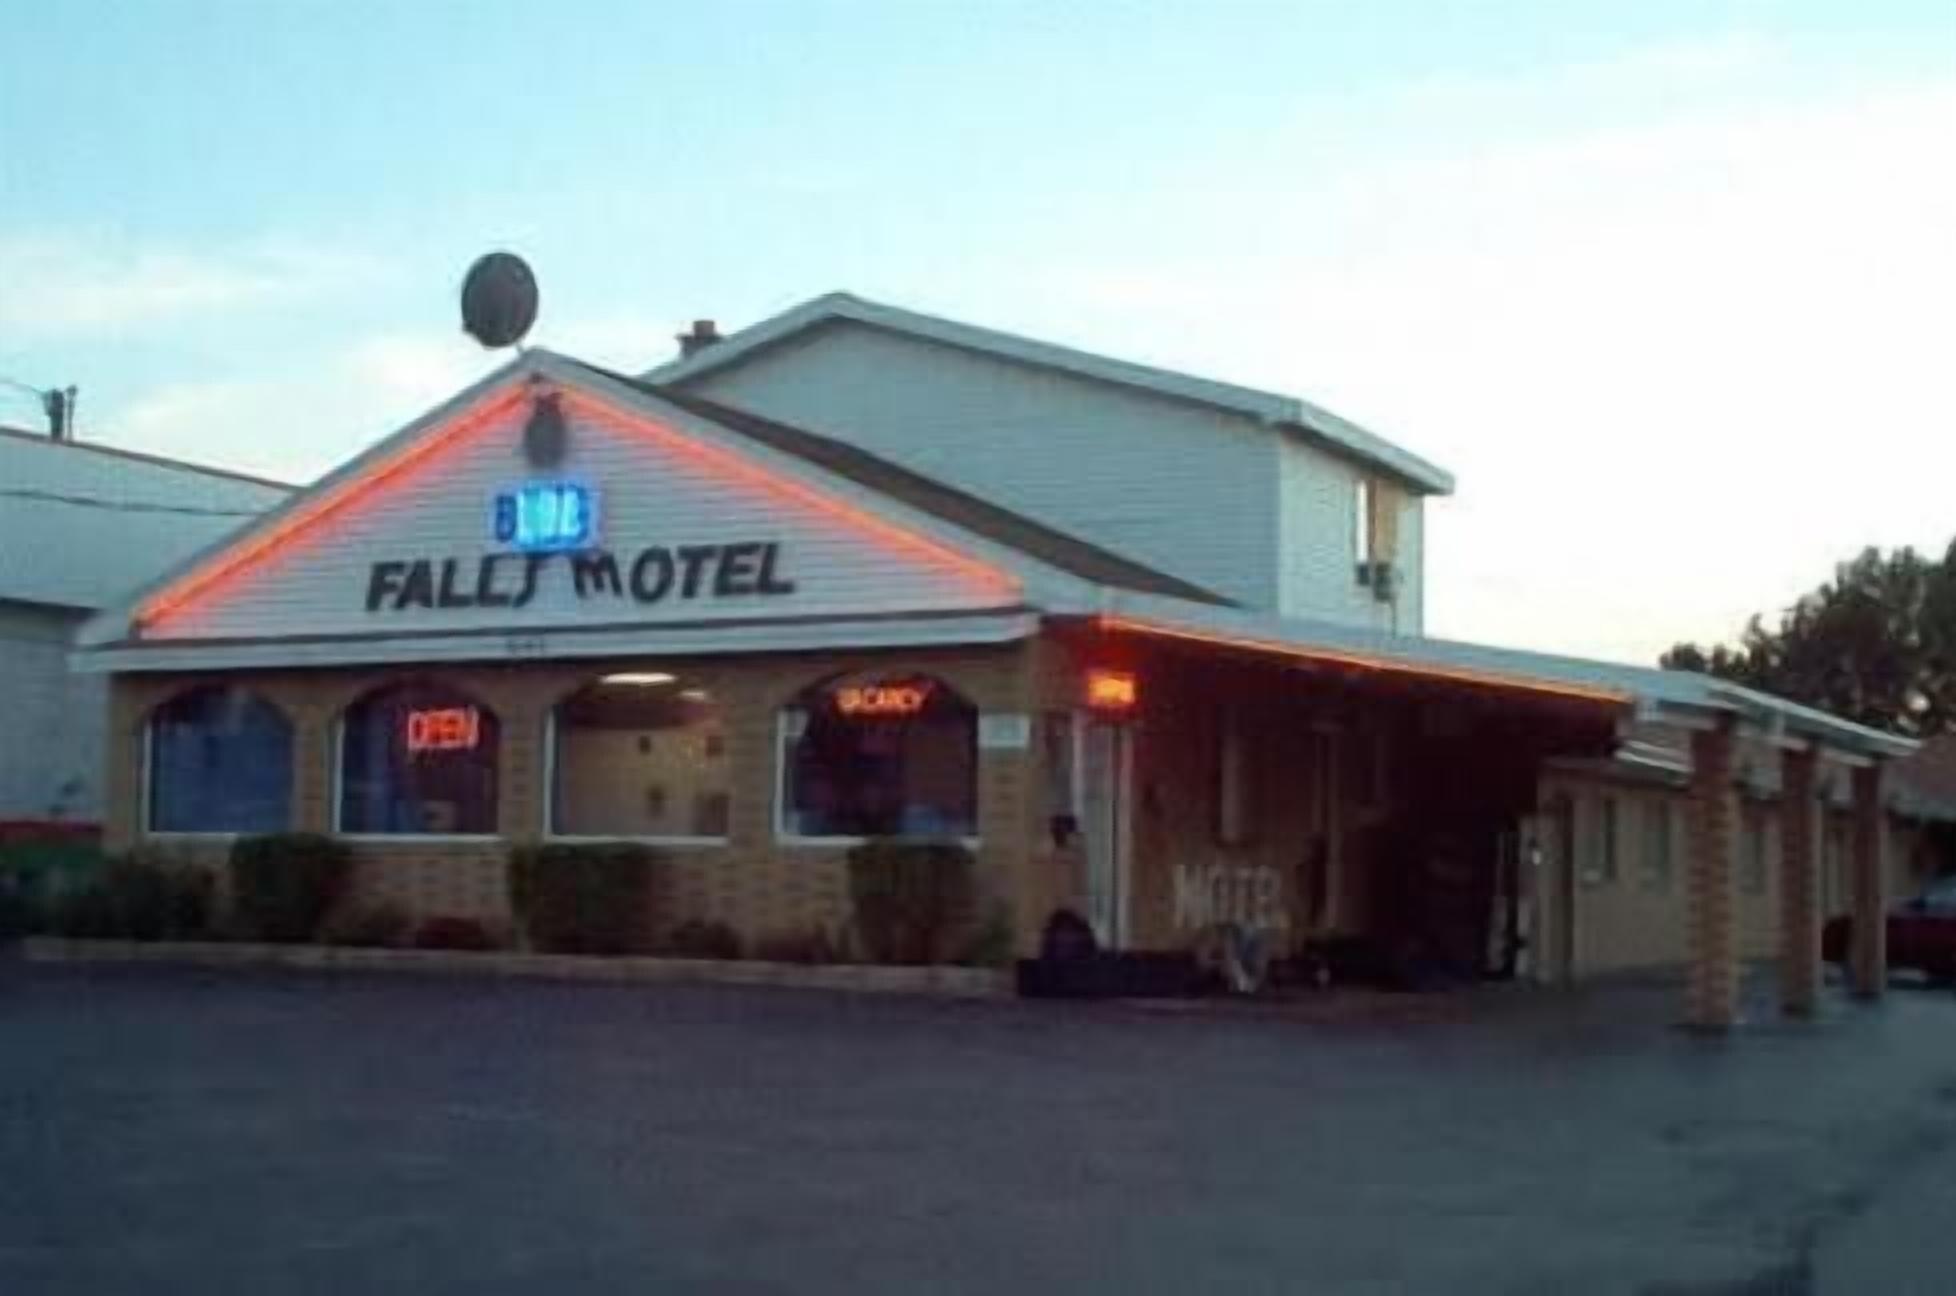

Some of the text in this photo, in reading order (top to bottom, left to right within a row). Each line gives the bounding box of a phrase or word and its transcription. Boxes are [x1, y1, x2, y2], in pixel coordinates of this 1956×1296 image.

[366, 543, 796, 611] FALLS MOTEL
[408, 708, 480, 750] OPEN
